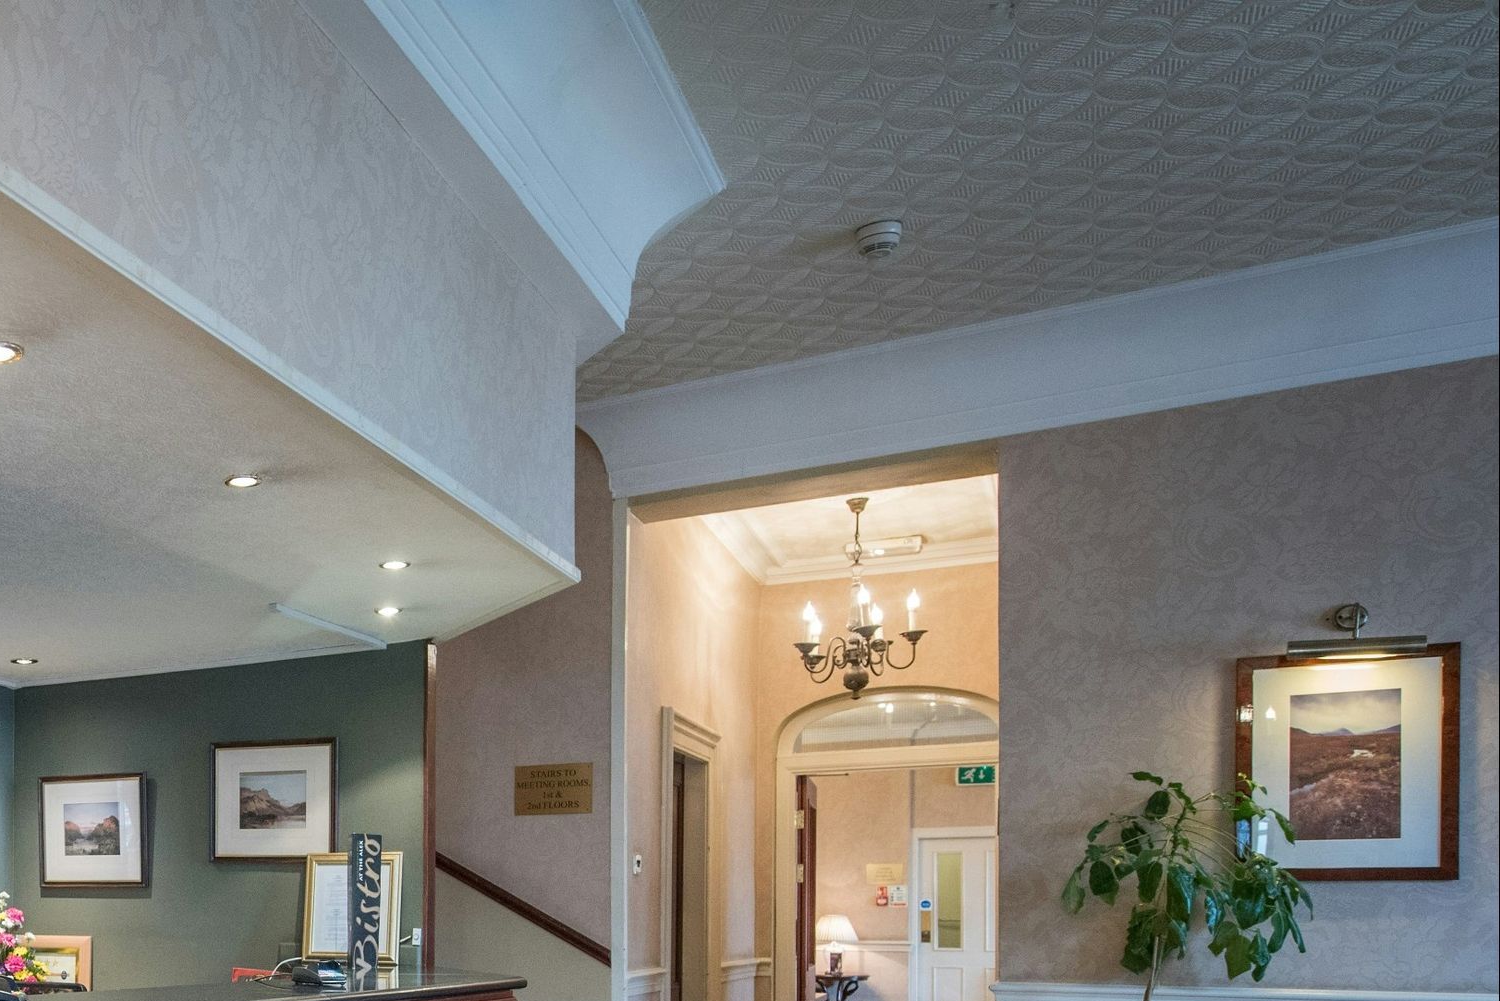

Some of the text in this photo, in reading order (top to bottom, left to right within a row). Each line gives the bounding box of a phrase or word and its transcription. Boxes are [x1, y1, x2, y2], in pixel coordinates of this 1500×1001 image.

[530, 769, 577, 778] STAIRS TO
[517, 780, 556, 789] MEETING
[543, 791, 553, 799] 1st
[527, 800, 580, 810] 2nd FLOORS
[358, 872, 364, 881] AT
[353, 833, 381, 969] Bistro
